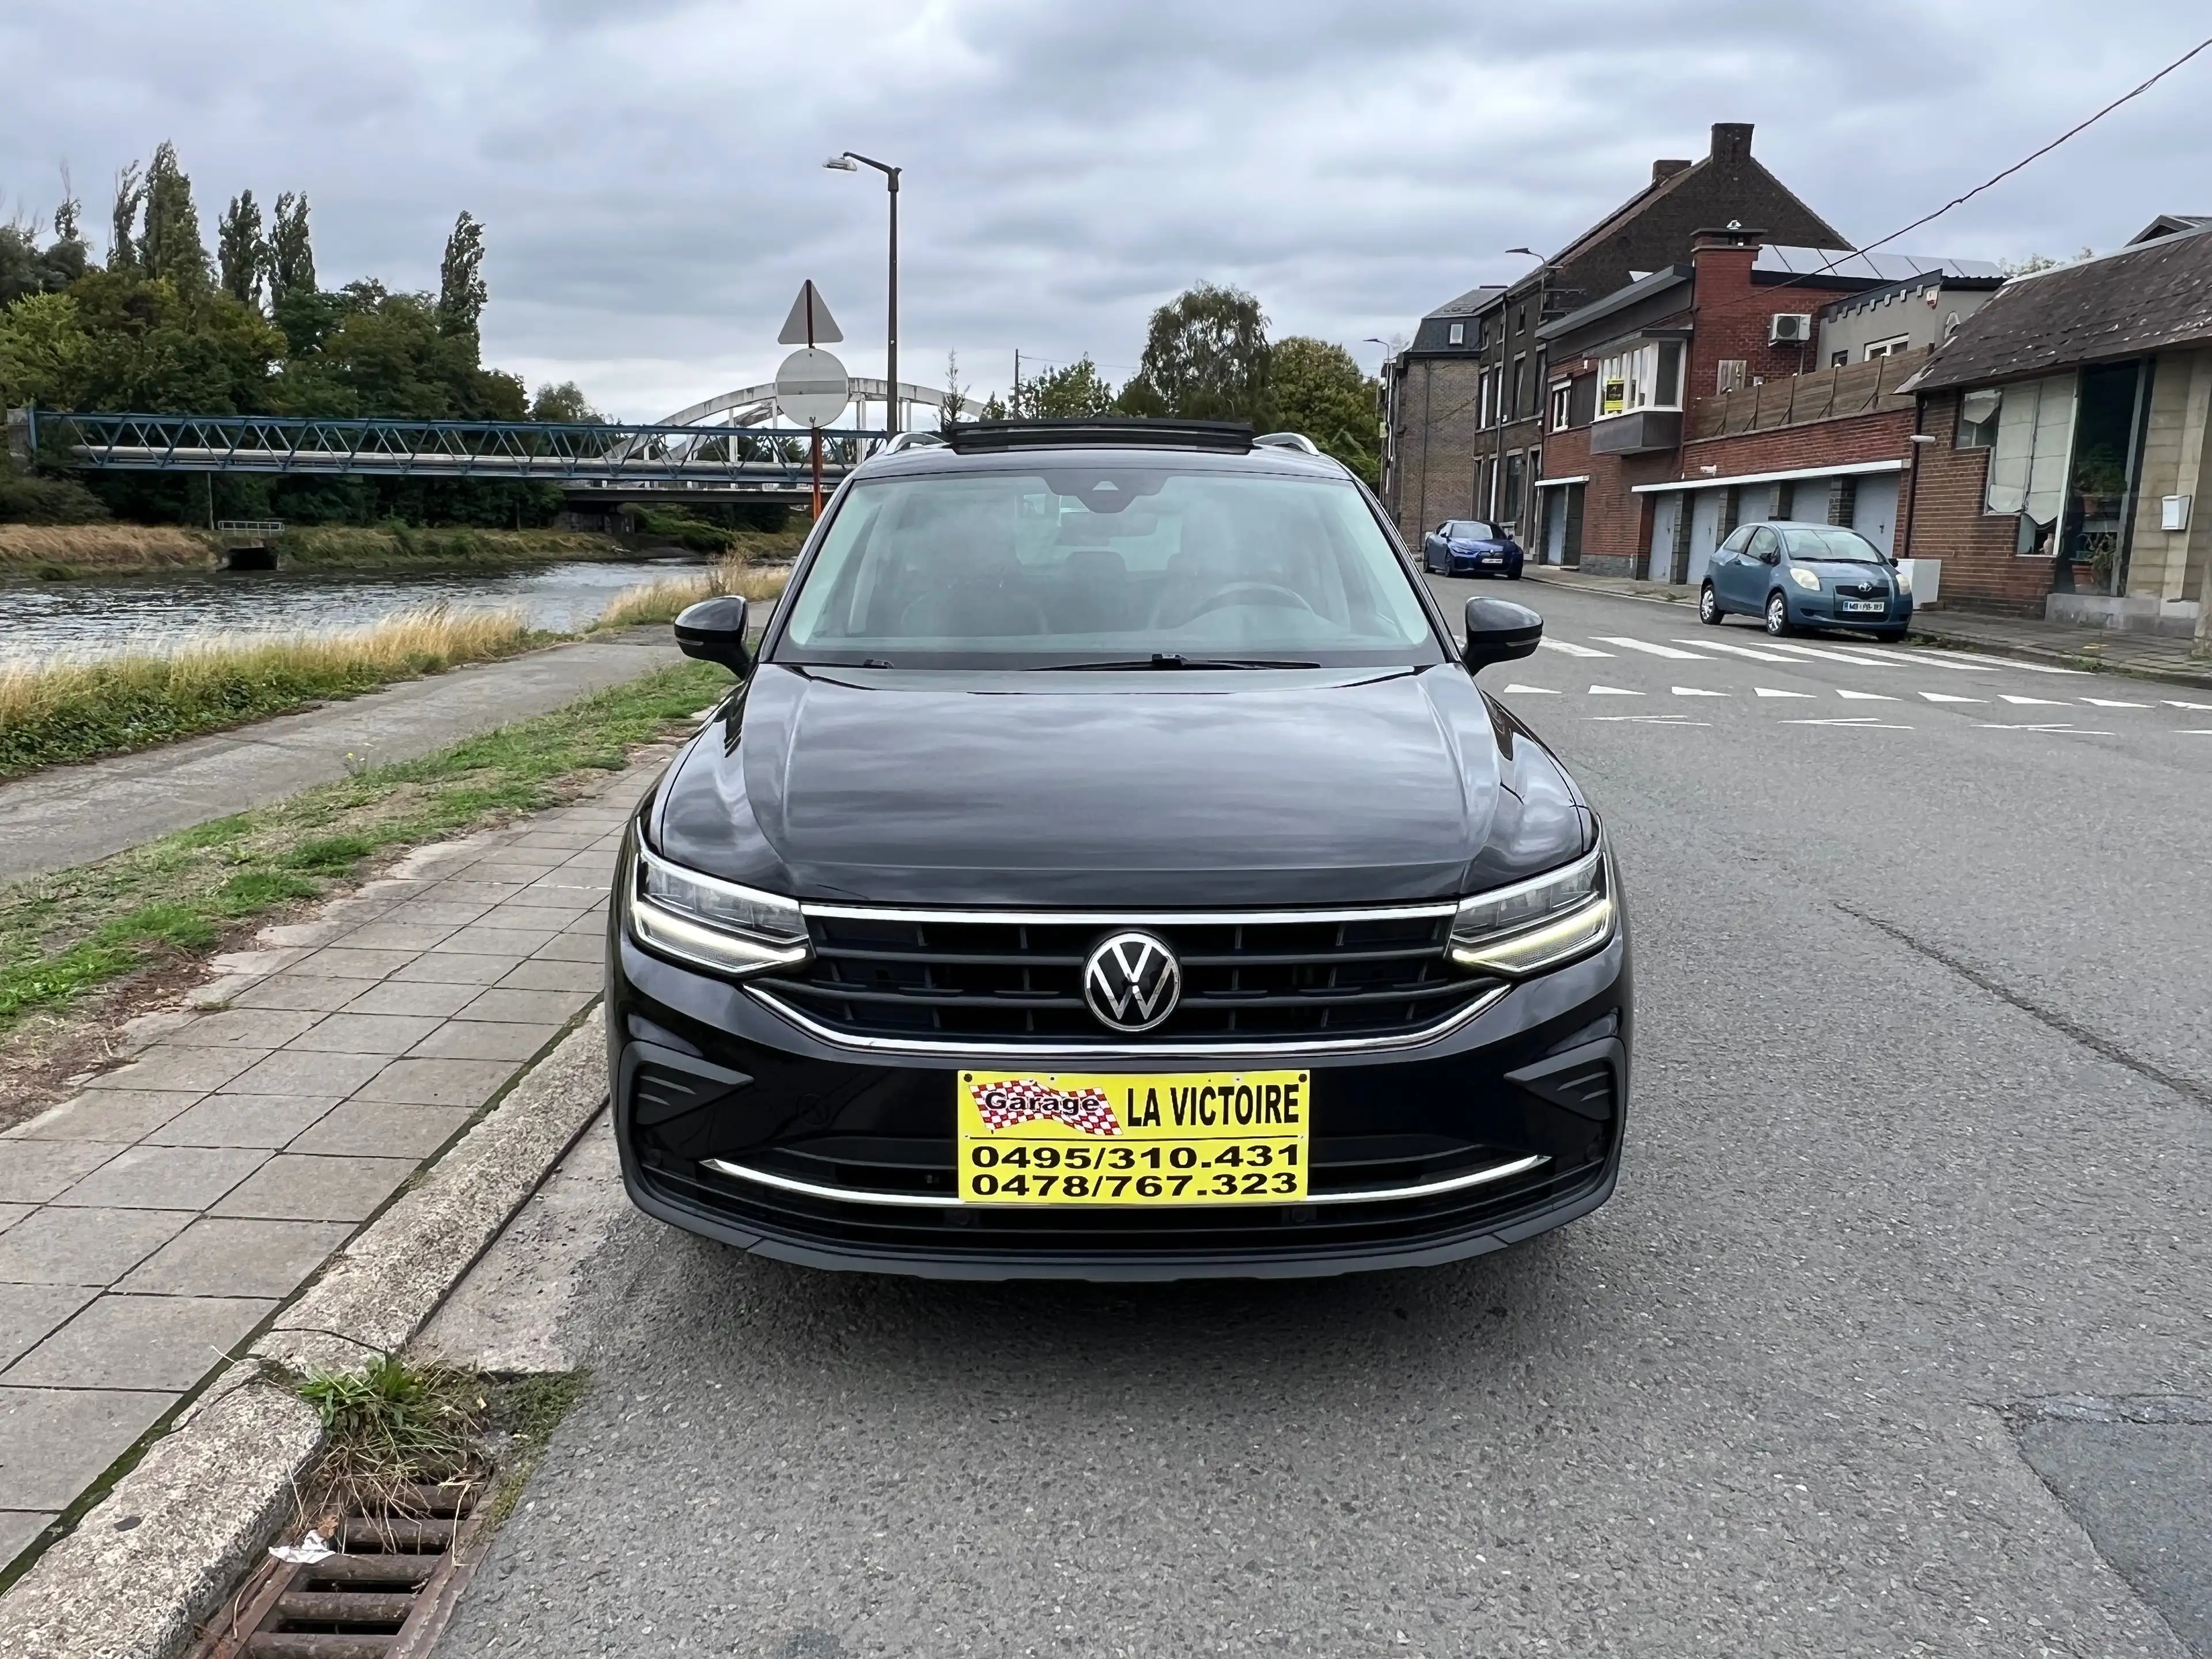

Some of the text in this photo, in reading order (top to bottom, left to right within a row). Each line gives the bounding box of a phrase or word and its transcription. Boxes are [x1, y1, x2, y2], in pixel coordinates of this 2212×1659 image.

[984, 1084, 1299, 1127] Garage LA VICTOIRE
[972, 1144, 1298, 1170] 0495/310.431
[972, 1173, 1297, 1198] 0478/767.323
